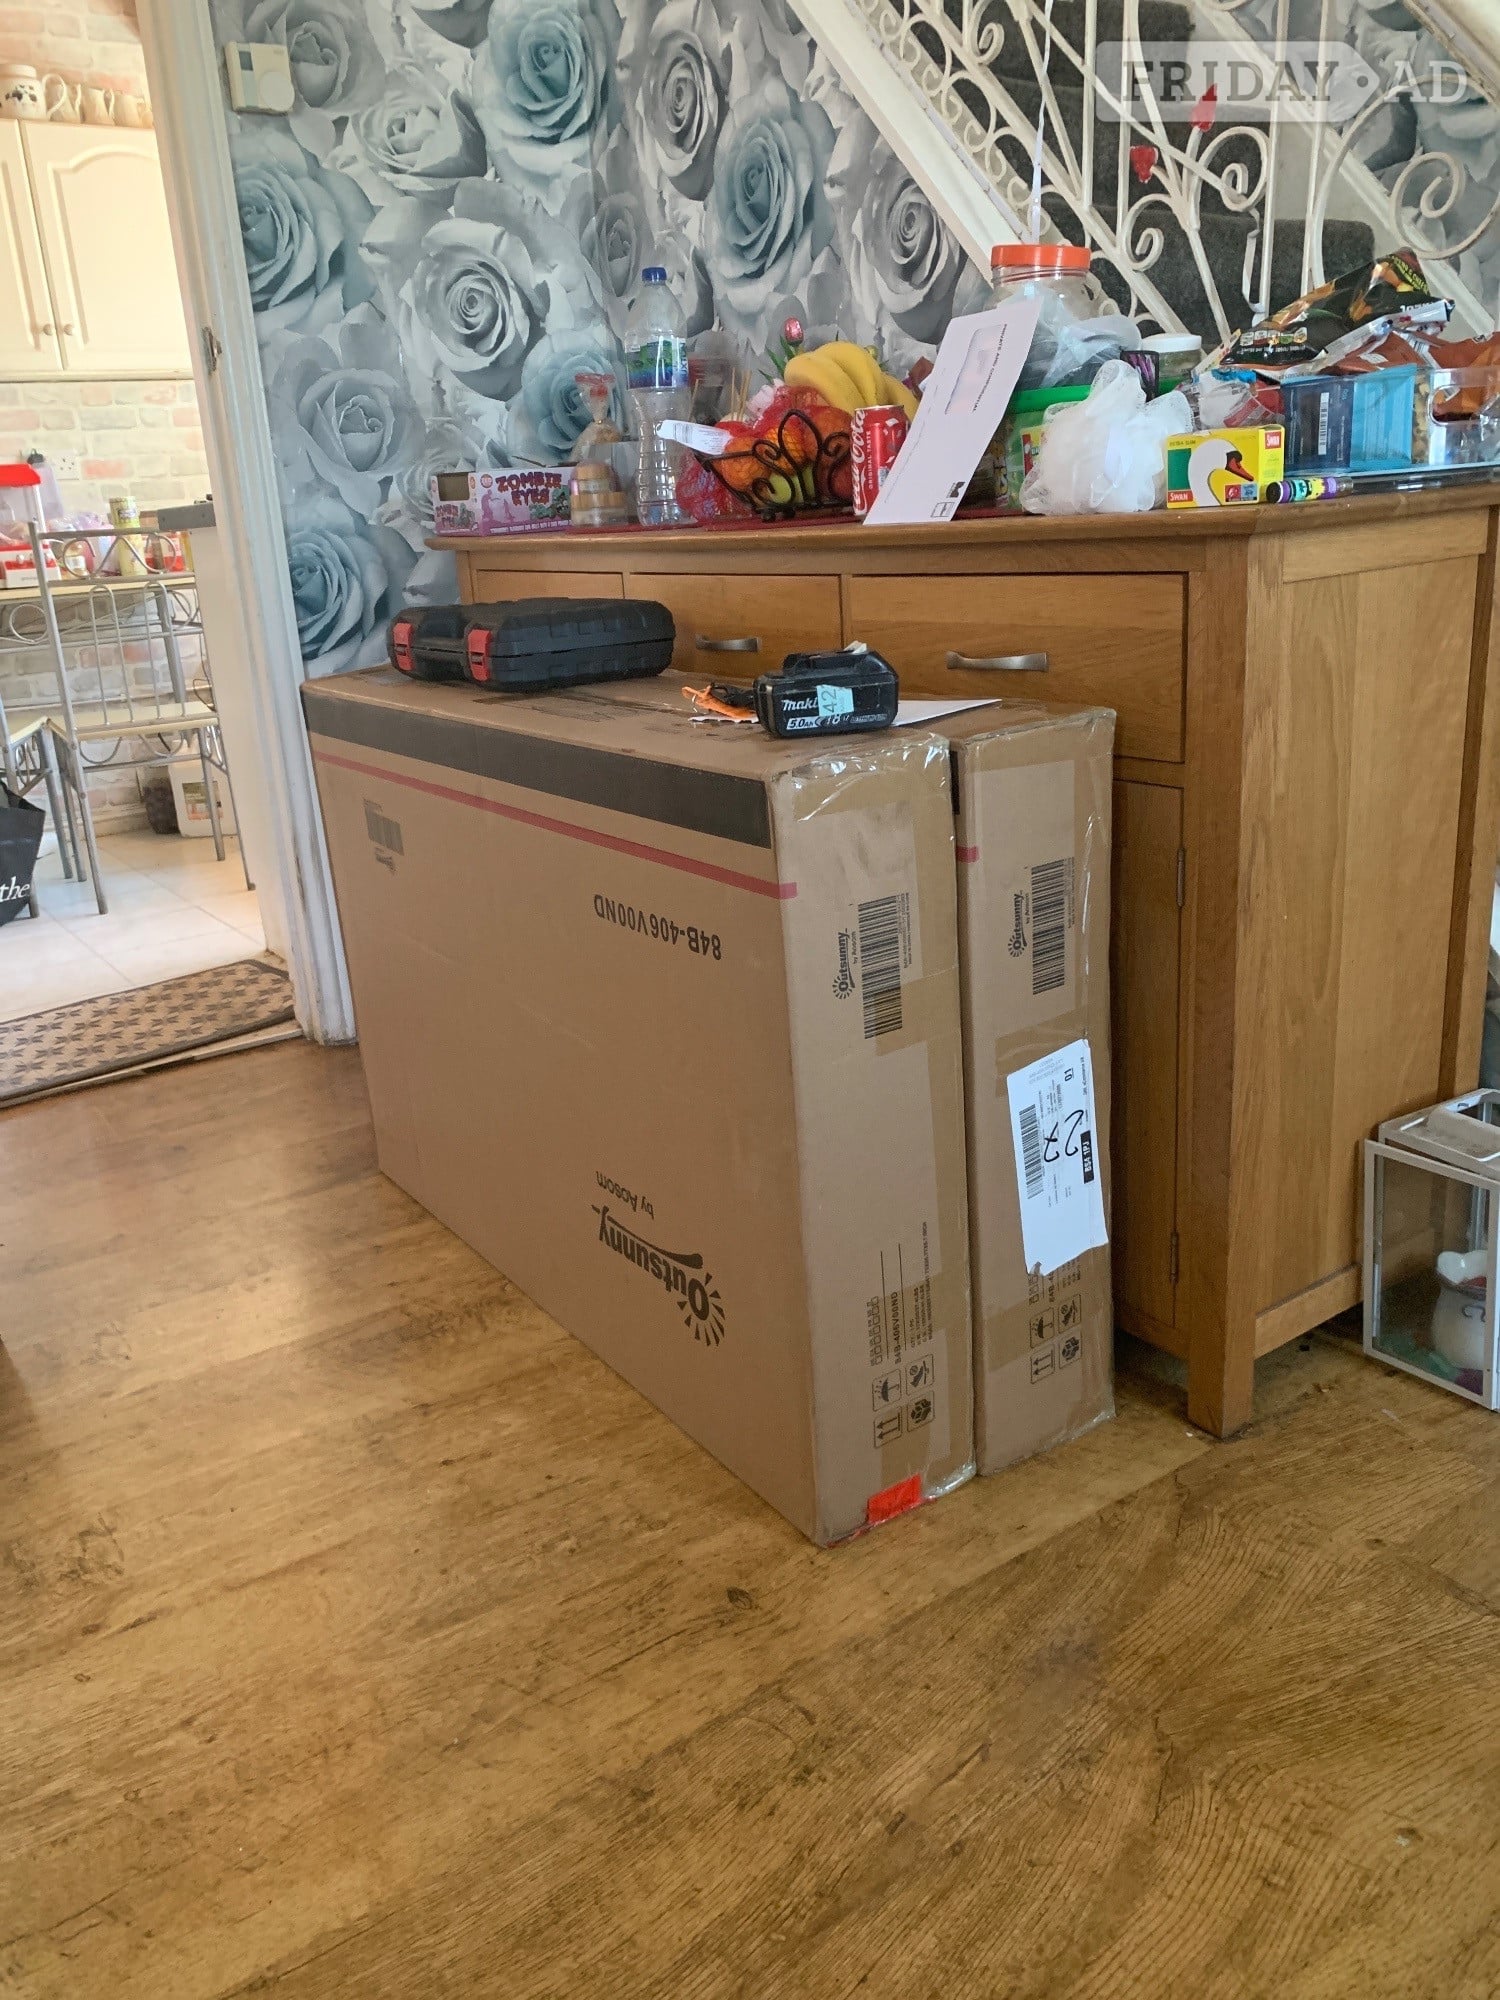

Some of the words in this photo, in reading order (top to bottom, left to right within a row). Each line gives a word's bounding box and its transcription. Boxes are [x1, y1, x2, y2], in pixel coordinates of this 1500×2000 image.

[1267, 434, 1280, 447] SWAN
[495, 471, 562, 493] ZOMBIE
[866, 455, 874, 490] ORIGINAL
[511, 488, 550, 506] EYES
[1169, 492, 1189, 502] SWAN
[820, 688, 838, 714] 42
[0, 875, 30, 903] the
[593, 894, 722, 960] 84B-406V00ND
[1012, 892, 1025, 951] Outsunny
[837, 929, 850, 992] Outsunny
[629, 1195, 655, 1221] by
[591, 1204, 711, 1322] Outsunny
